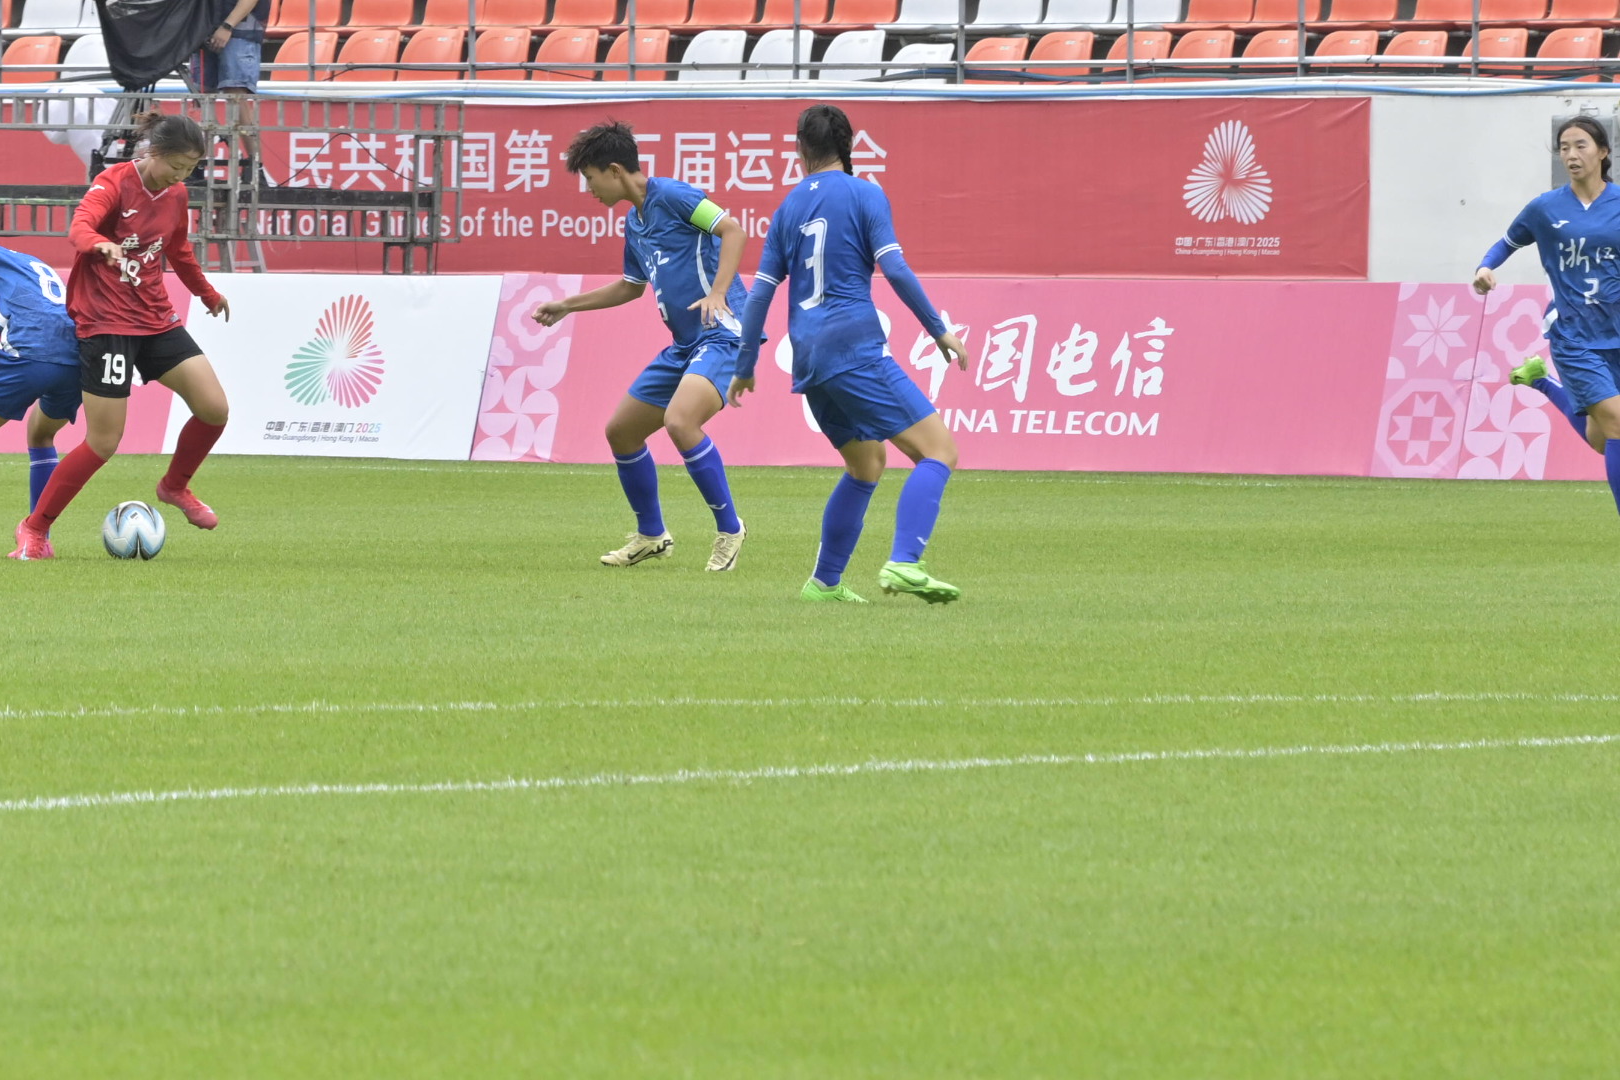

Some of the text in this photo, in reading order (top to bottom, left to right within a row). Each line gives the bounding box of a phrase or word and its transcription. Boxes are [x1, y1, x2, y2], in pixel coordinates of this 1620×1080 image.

[460, 206, 486, 237] of
[491, 210, 533, 237] the
[1256, 237, 1280, 248] 2025
[117, 257, 142, 287] 19
[797, 217, 828, 310] 3
[29, 261, 67, 305] 8
[1584, 278, 1600, 305] 2
[101, 353, 127, 385] 19
[909, 310, 1175, 403] 中国电信
[355, 423, 381, 433] 2025
[1009, 409, 1160, 437] TELECOM
